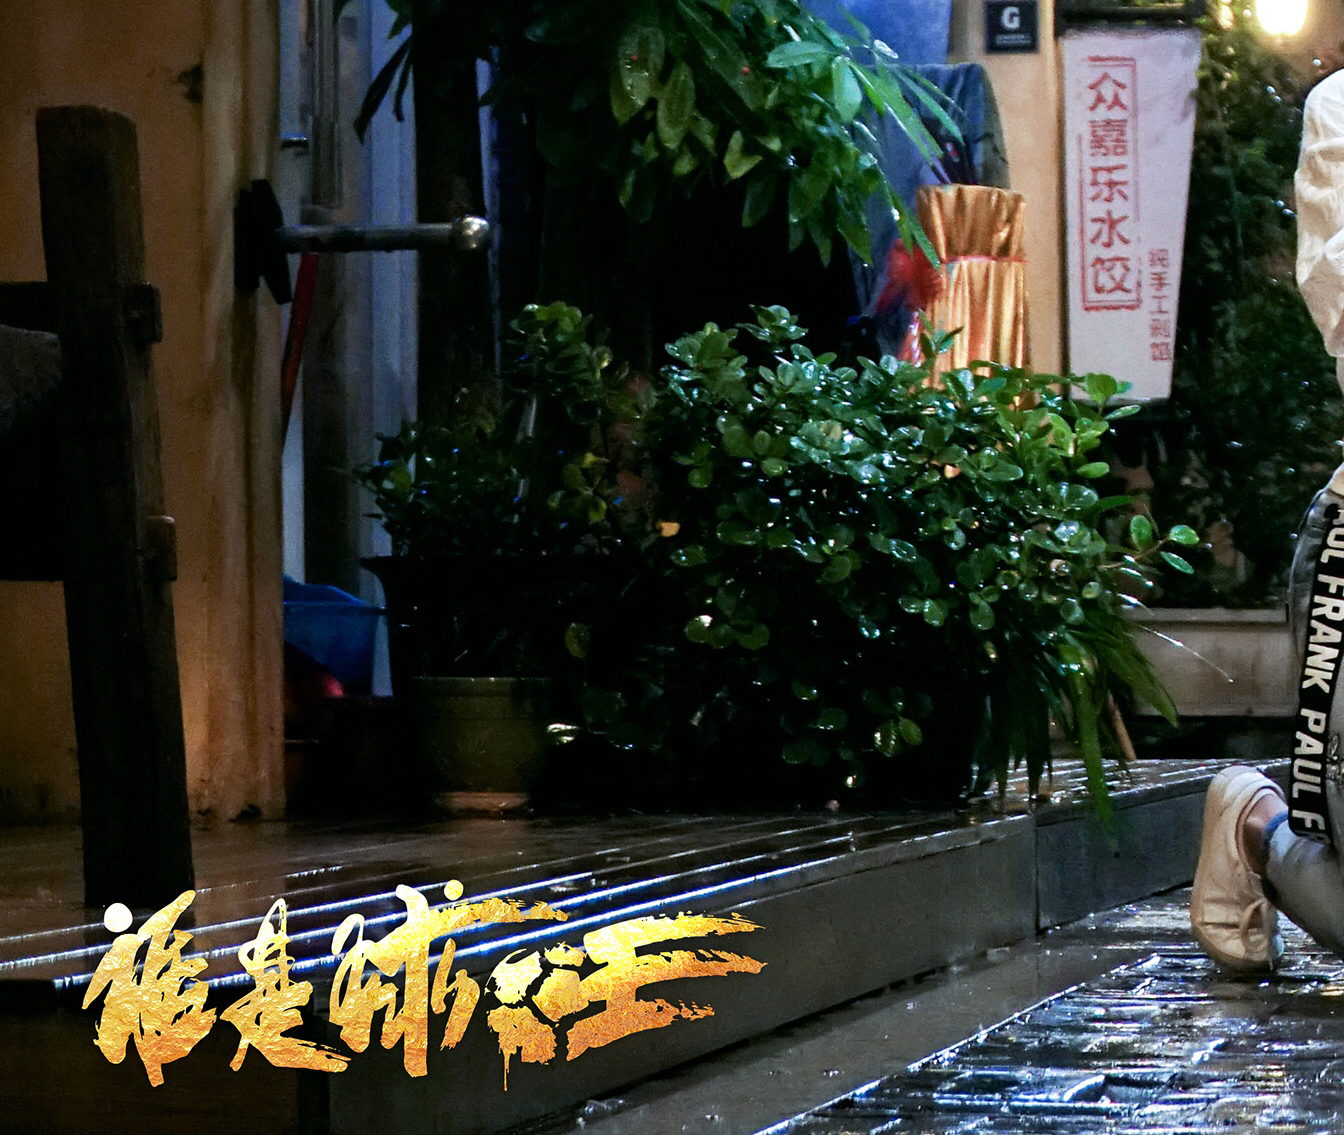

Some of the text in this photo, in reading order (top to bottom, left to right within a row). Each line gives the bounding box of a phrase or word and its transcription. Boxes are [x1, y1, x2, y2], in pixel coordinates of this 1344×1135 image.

[1001, 6, 1021, 30] G
[1087, 72, 1131, 295] 众嘉乐水饺
[1292, 708, 1327, 799] PAUL
